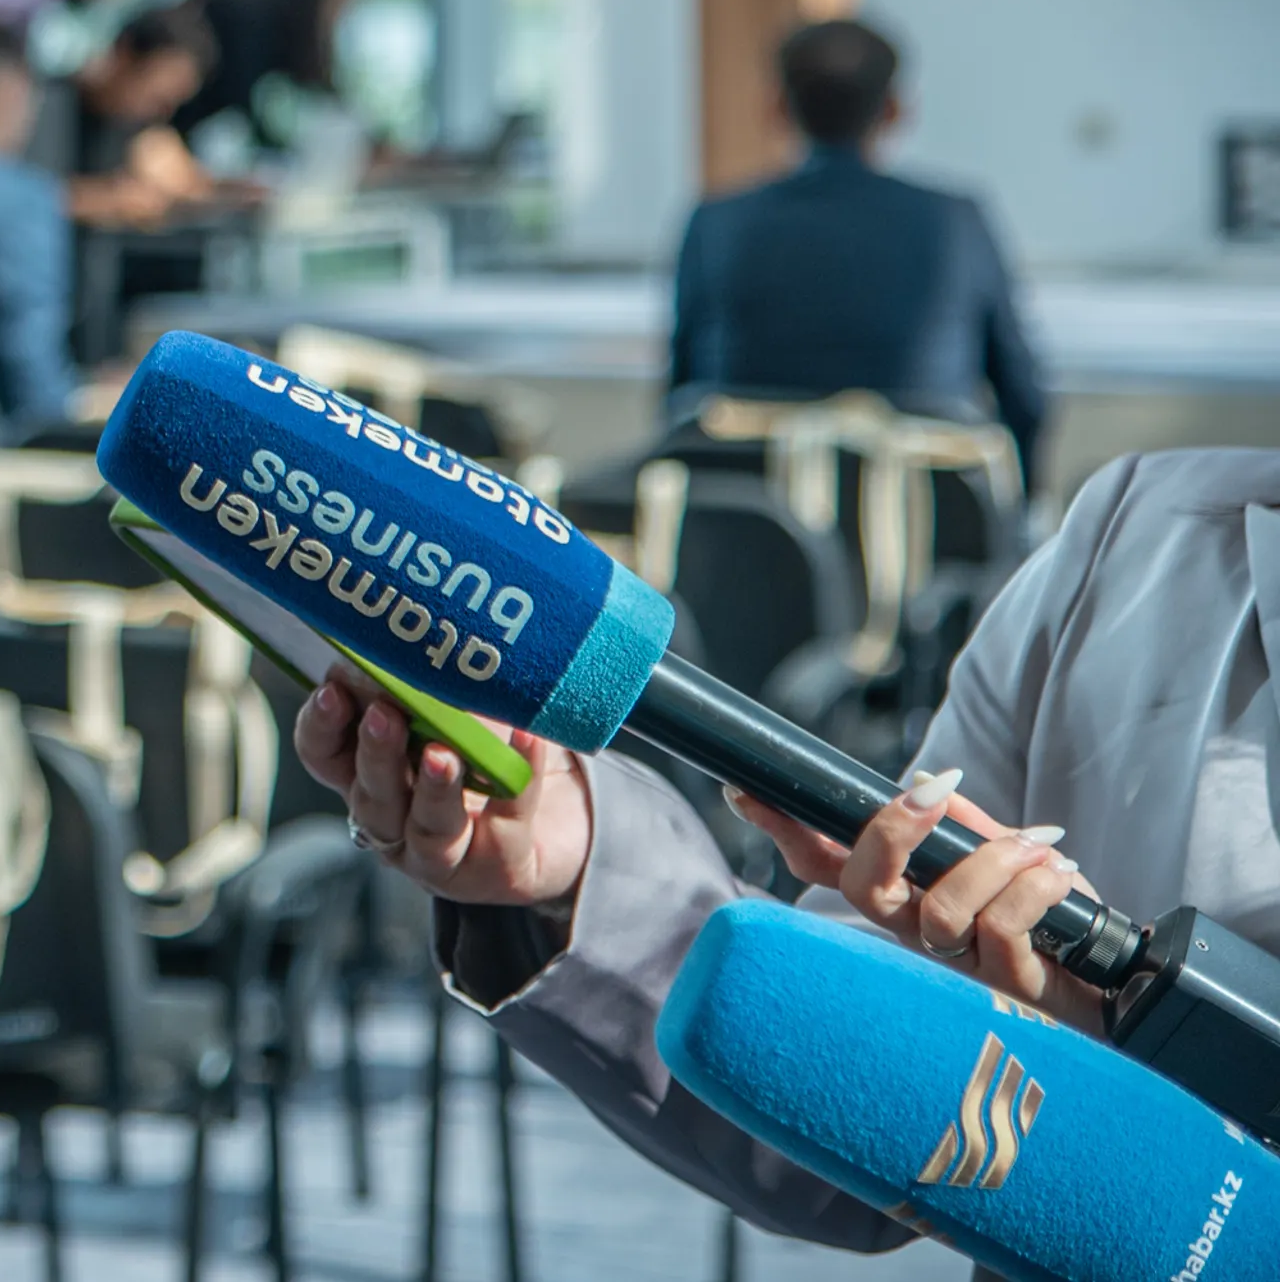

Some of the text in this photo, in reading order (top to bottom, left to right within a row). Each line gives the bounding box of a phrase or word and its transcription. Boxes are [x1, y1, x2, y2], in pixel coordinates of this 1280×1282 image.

[243, 449, 534, 645] business
[247, 363, 573, 545] atameken
[179, 462, 502, 681] atameken
